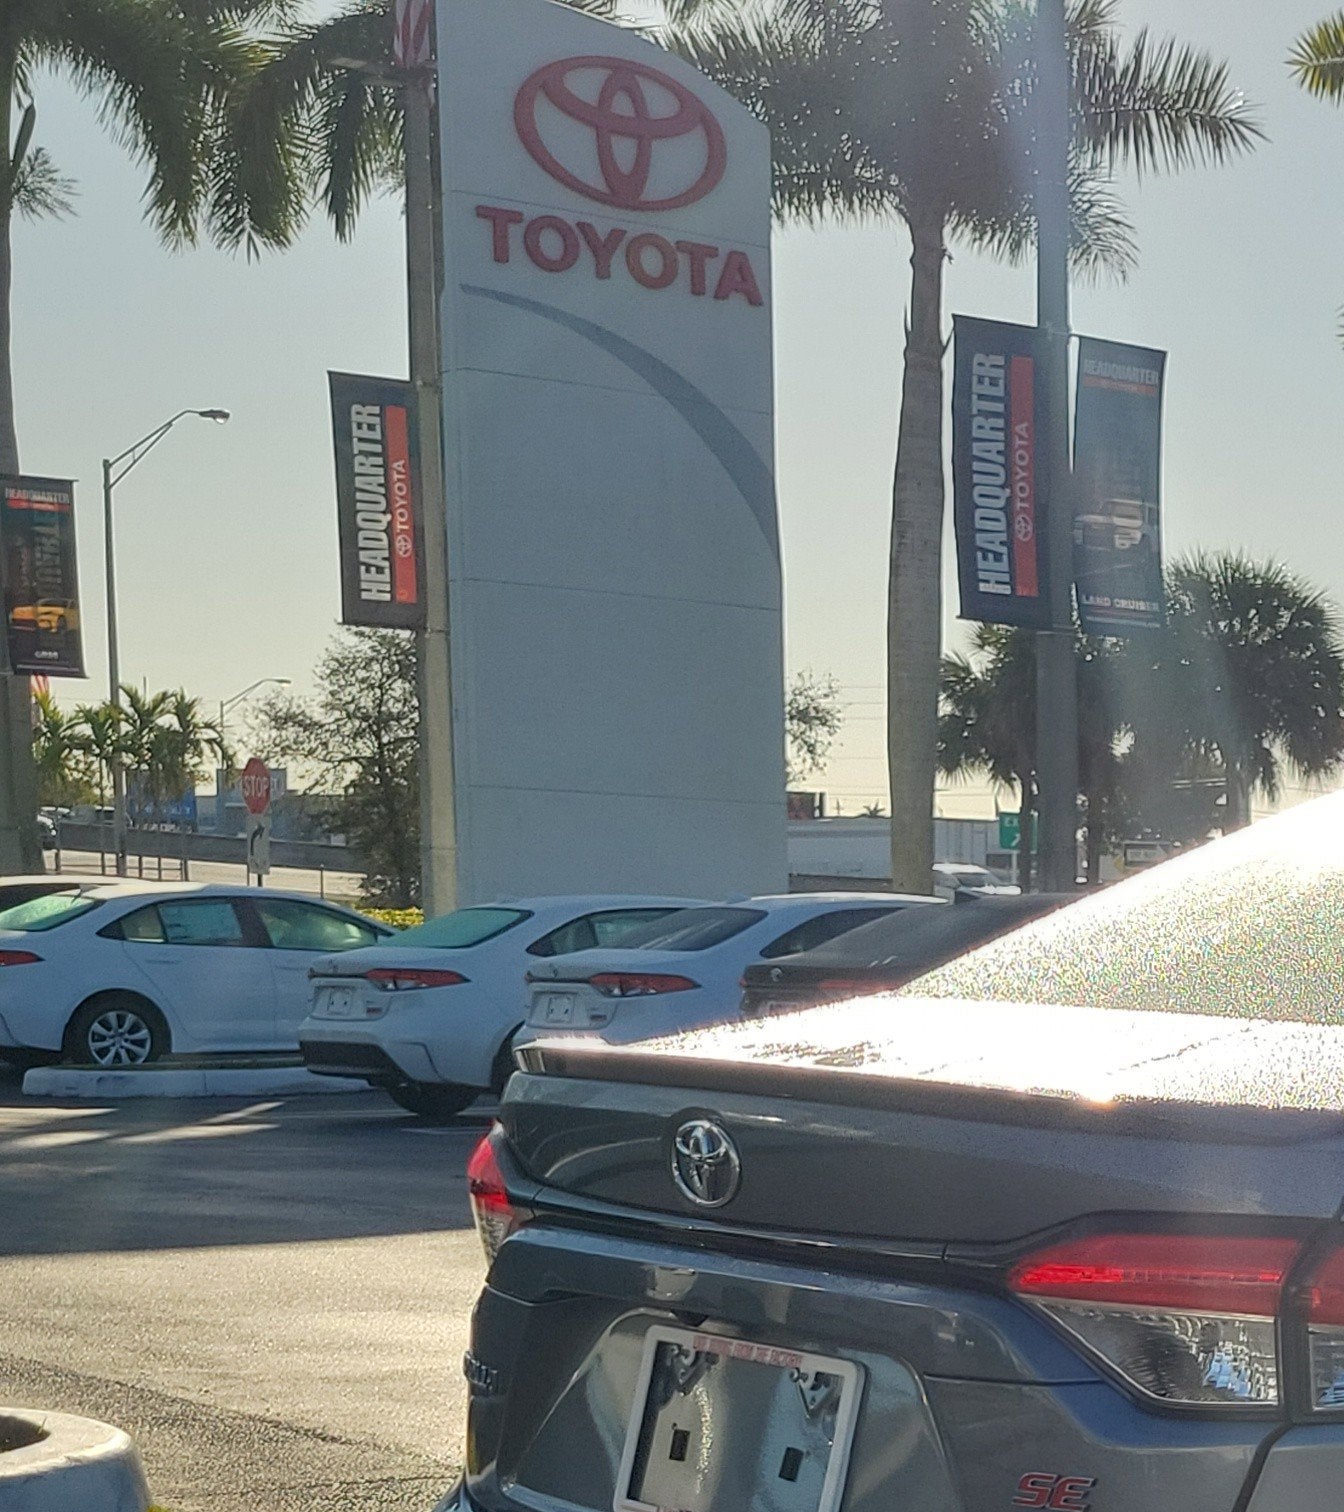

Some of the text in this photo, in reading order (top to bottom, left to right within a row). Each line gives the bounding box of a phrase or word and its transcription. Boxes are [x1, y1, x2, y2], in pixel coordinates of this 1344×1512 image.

[475, 205, 763, 306] TOYOTA
[350, 403, 392, 601] HEADQUARTER
[391, 459, 410, 533] TOYOTA
[972, 352, 1011, 595] HEADQUARTER
[1013, 421, 1030, 512] TOYOTA
[243, 775, 271, 797] STOP
